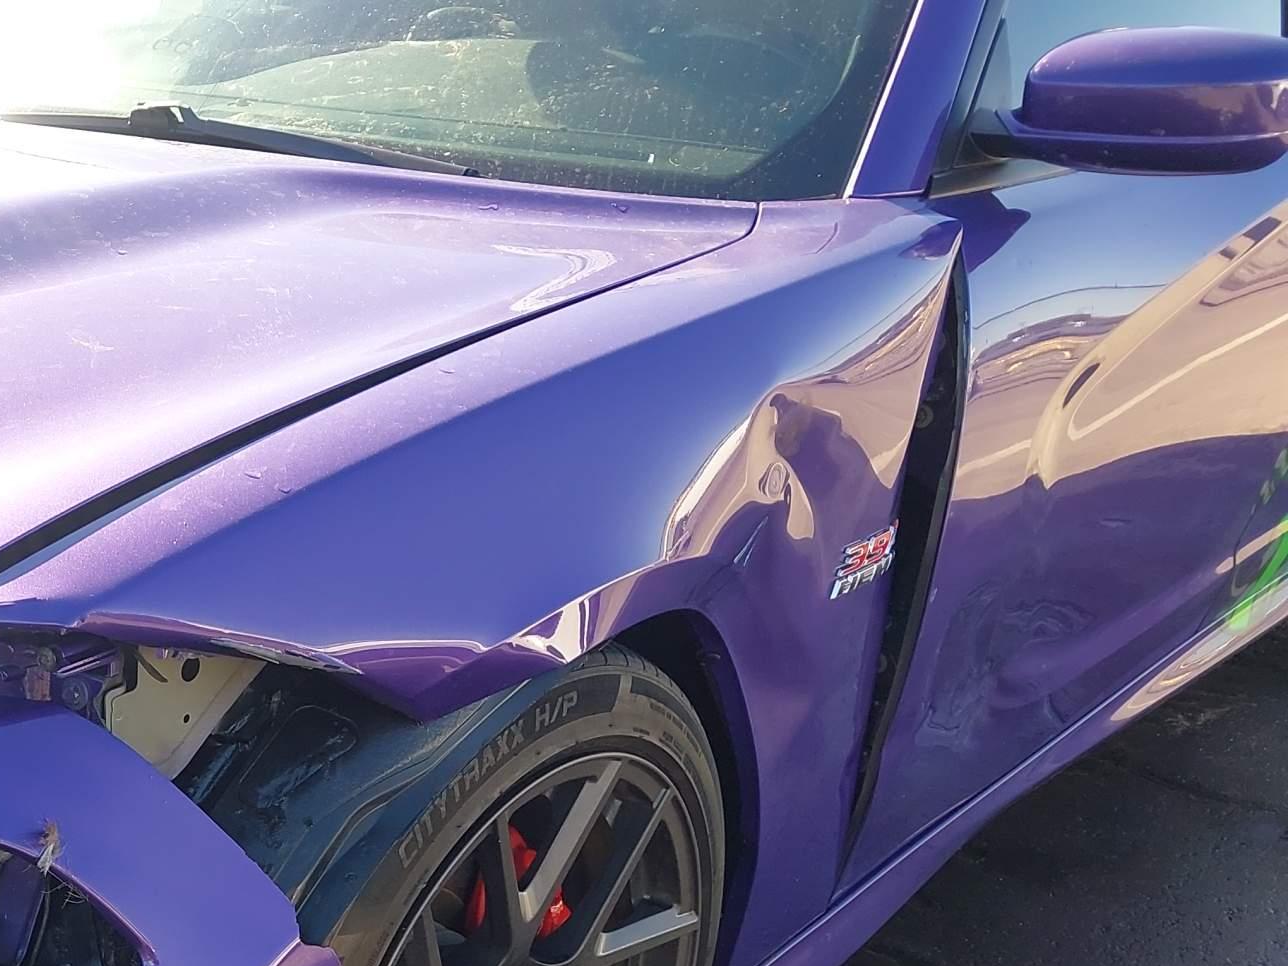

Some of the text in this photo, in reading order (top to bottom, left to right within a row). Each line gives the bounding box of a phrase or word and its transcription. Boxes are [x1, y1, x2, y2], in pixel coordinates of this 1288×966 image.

[830, 552, 895, 600] HEM
[835, 520, 899, 578] 39
[398, 718, 527, 870] CITYTRAXX
[536, 689, 580, 733] H/P
